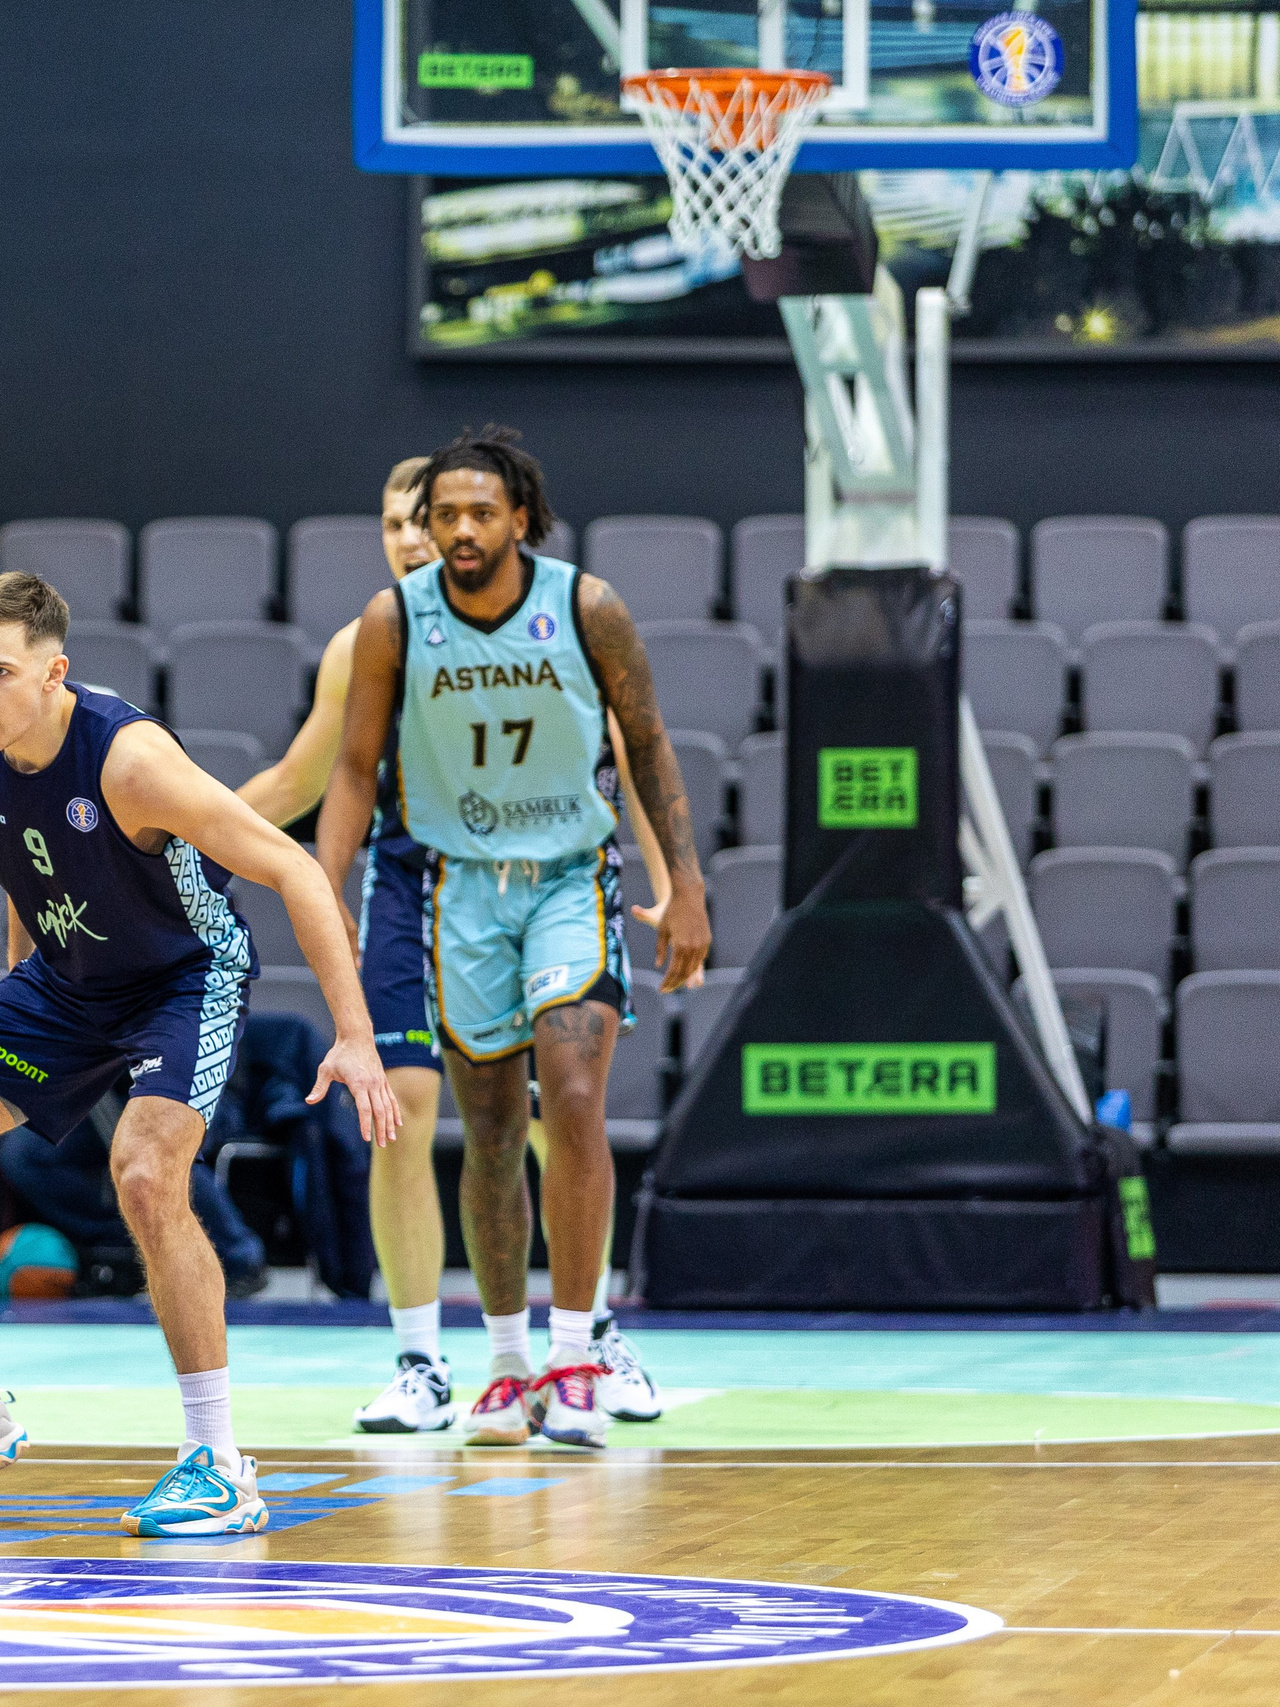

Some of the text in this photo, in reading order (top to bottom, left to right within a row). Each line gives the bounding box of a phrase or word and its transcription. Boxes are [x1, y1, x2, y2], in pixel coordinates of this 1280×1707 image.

[430, 657, 564, 699] ASTANA
[468, 716, 536, 769] 17
[22, 827, 55, 878] 9
